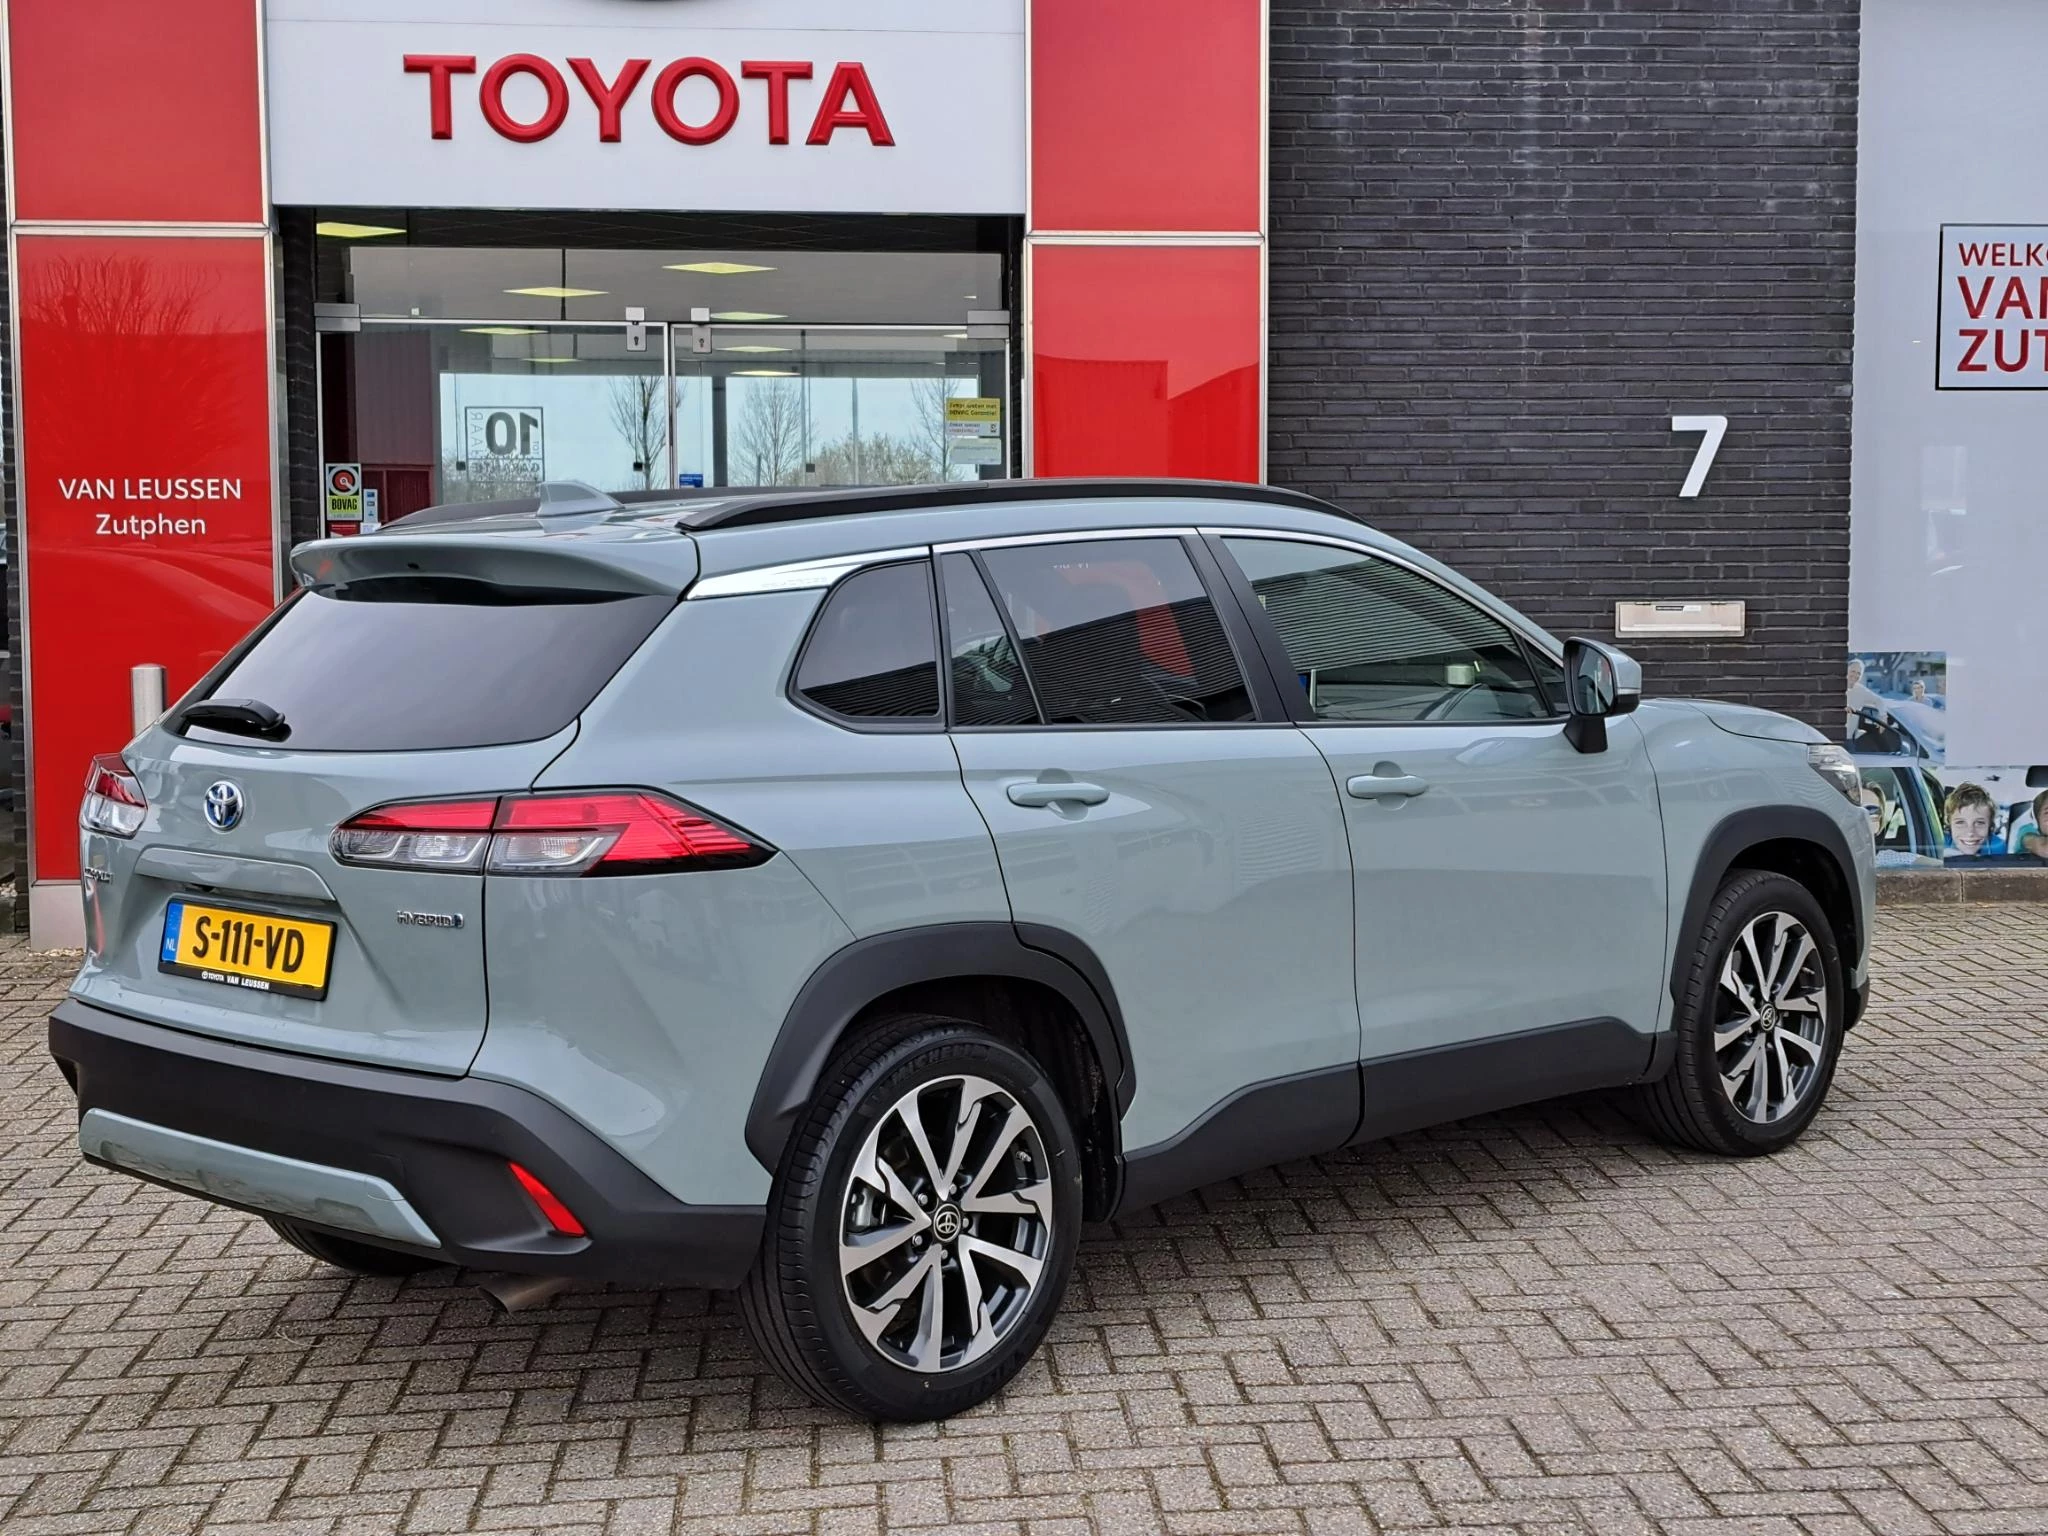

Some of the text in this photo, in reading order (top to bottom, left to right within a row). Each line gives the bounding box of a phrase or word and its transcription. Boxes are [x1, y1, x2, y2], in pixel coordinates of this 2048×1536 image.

[403, 53, 896, 146] TOYOTA
[1958, 242, 2048, 267] WELK
[1672, 415, 1728, 497] 7
[58, 478, 241, 500] VAN LEUSSEN
[331, 498, 358, 511] BOVAG
[96, 512, 206, 540] Zutphen
[397, 910, 453, 928] HYBRID
[165, 937, 176, 951] NL
[192, 916, 304, 973] S-111-VD
[226, 975, 239, 985] VAN
[241, 977, 270, 990] LEUSSEN
